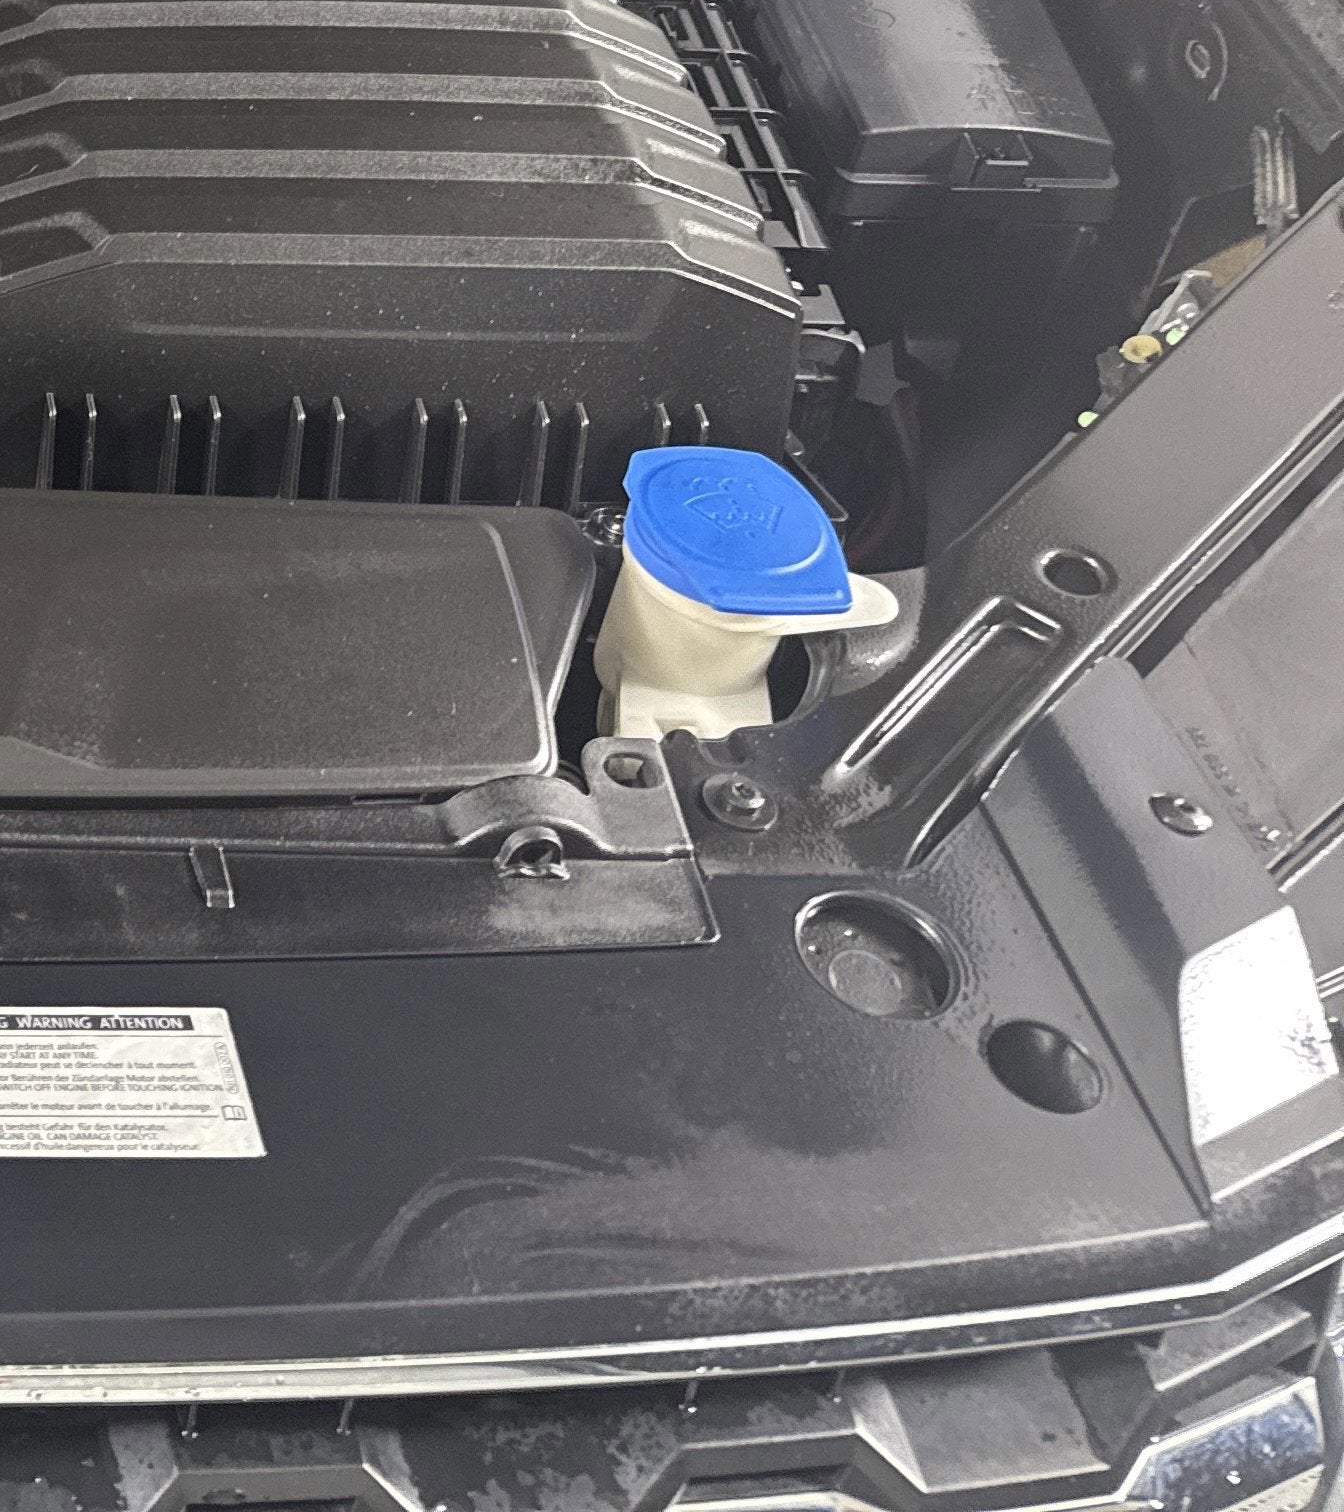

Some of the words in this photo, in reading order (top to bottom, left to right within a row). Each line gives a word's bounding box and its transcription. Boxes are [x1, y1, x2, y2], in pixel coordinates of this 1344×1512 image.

[15, 1015, 93, 1029] WARNING
[99, 1015, 183, 1029] ATTENTION
[11, 1051, 36, 1059] START
[46, 1132, 68, 1140] CAN
